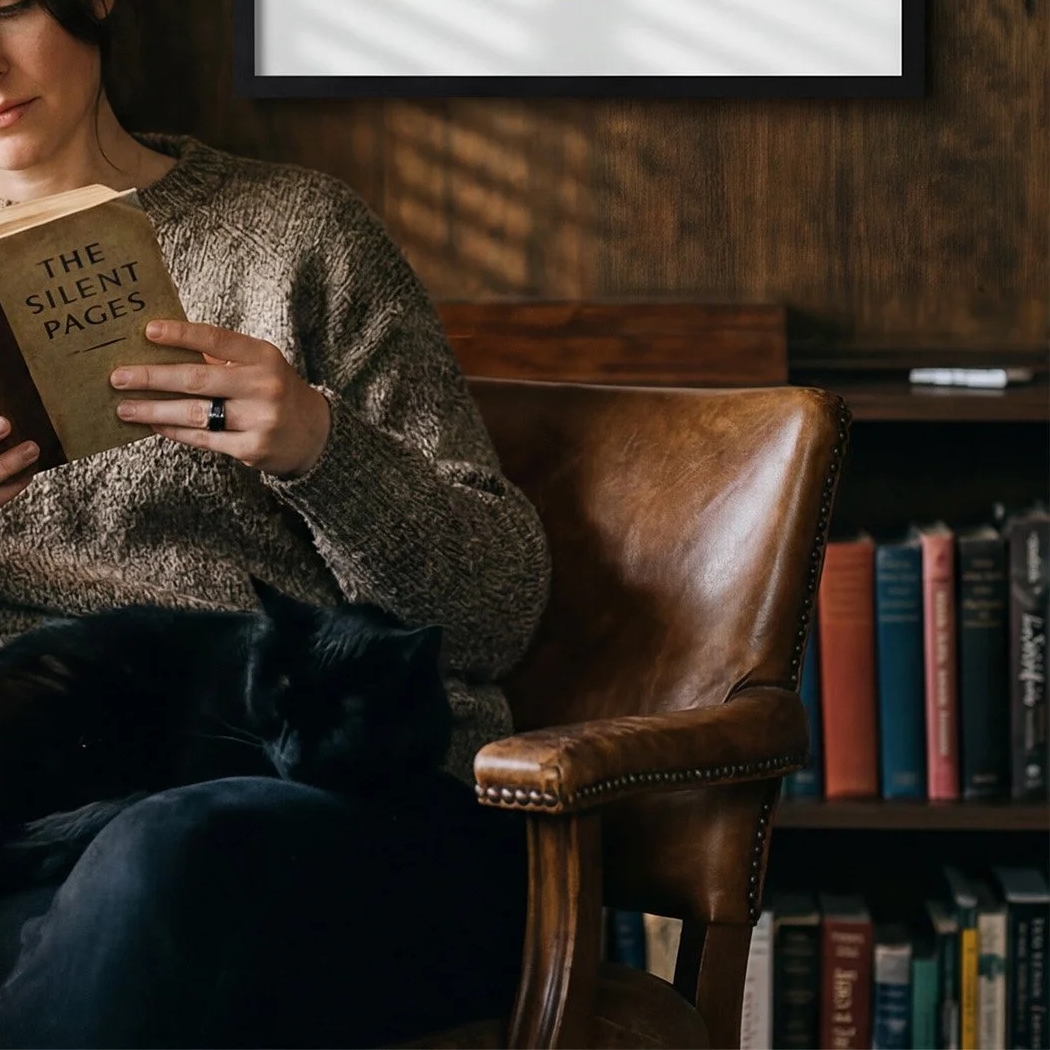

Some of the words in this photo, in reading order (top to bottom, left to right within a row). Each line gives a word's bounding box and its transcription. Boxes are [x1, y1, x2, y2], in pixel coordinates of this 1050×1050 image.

[36, 242, 106, 279] THE
[25, 261, 138, 314] SILENT
[43, 291, 146, 340] PAGES
